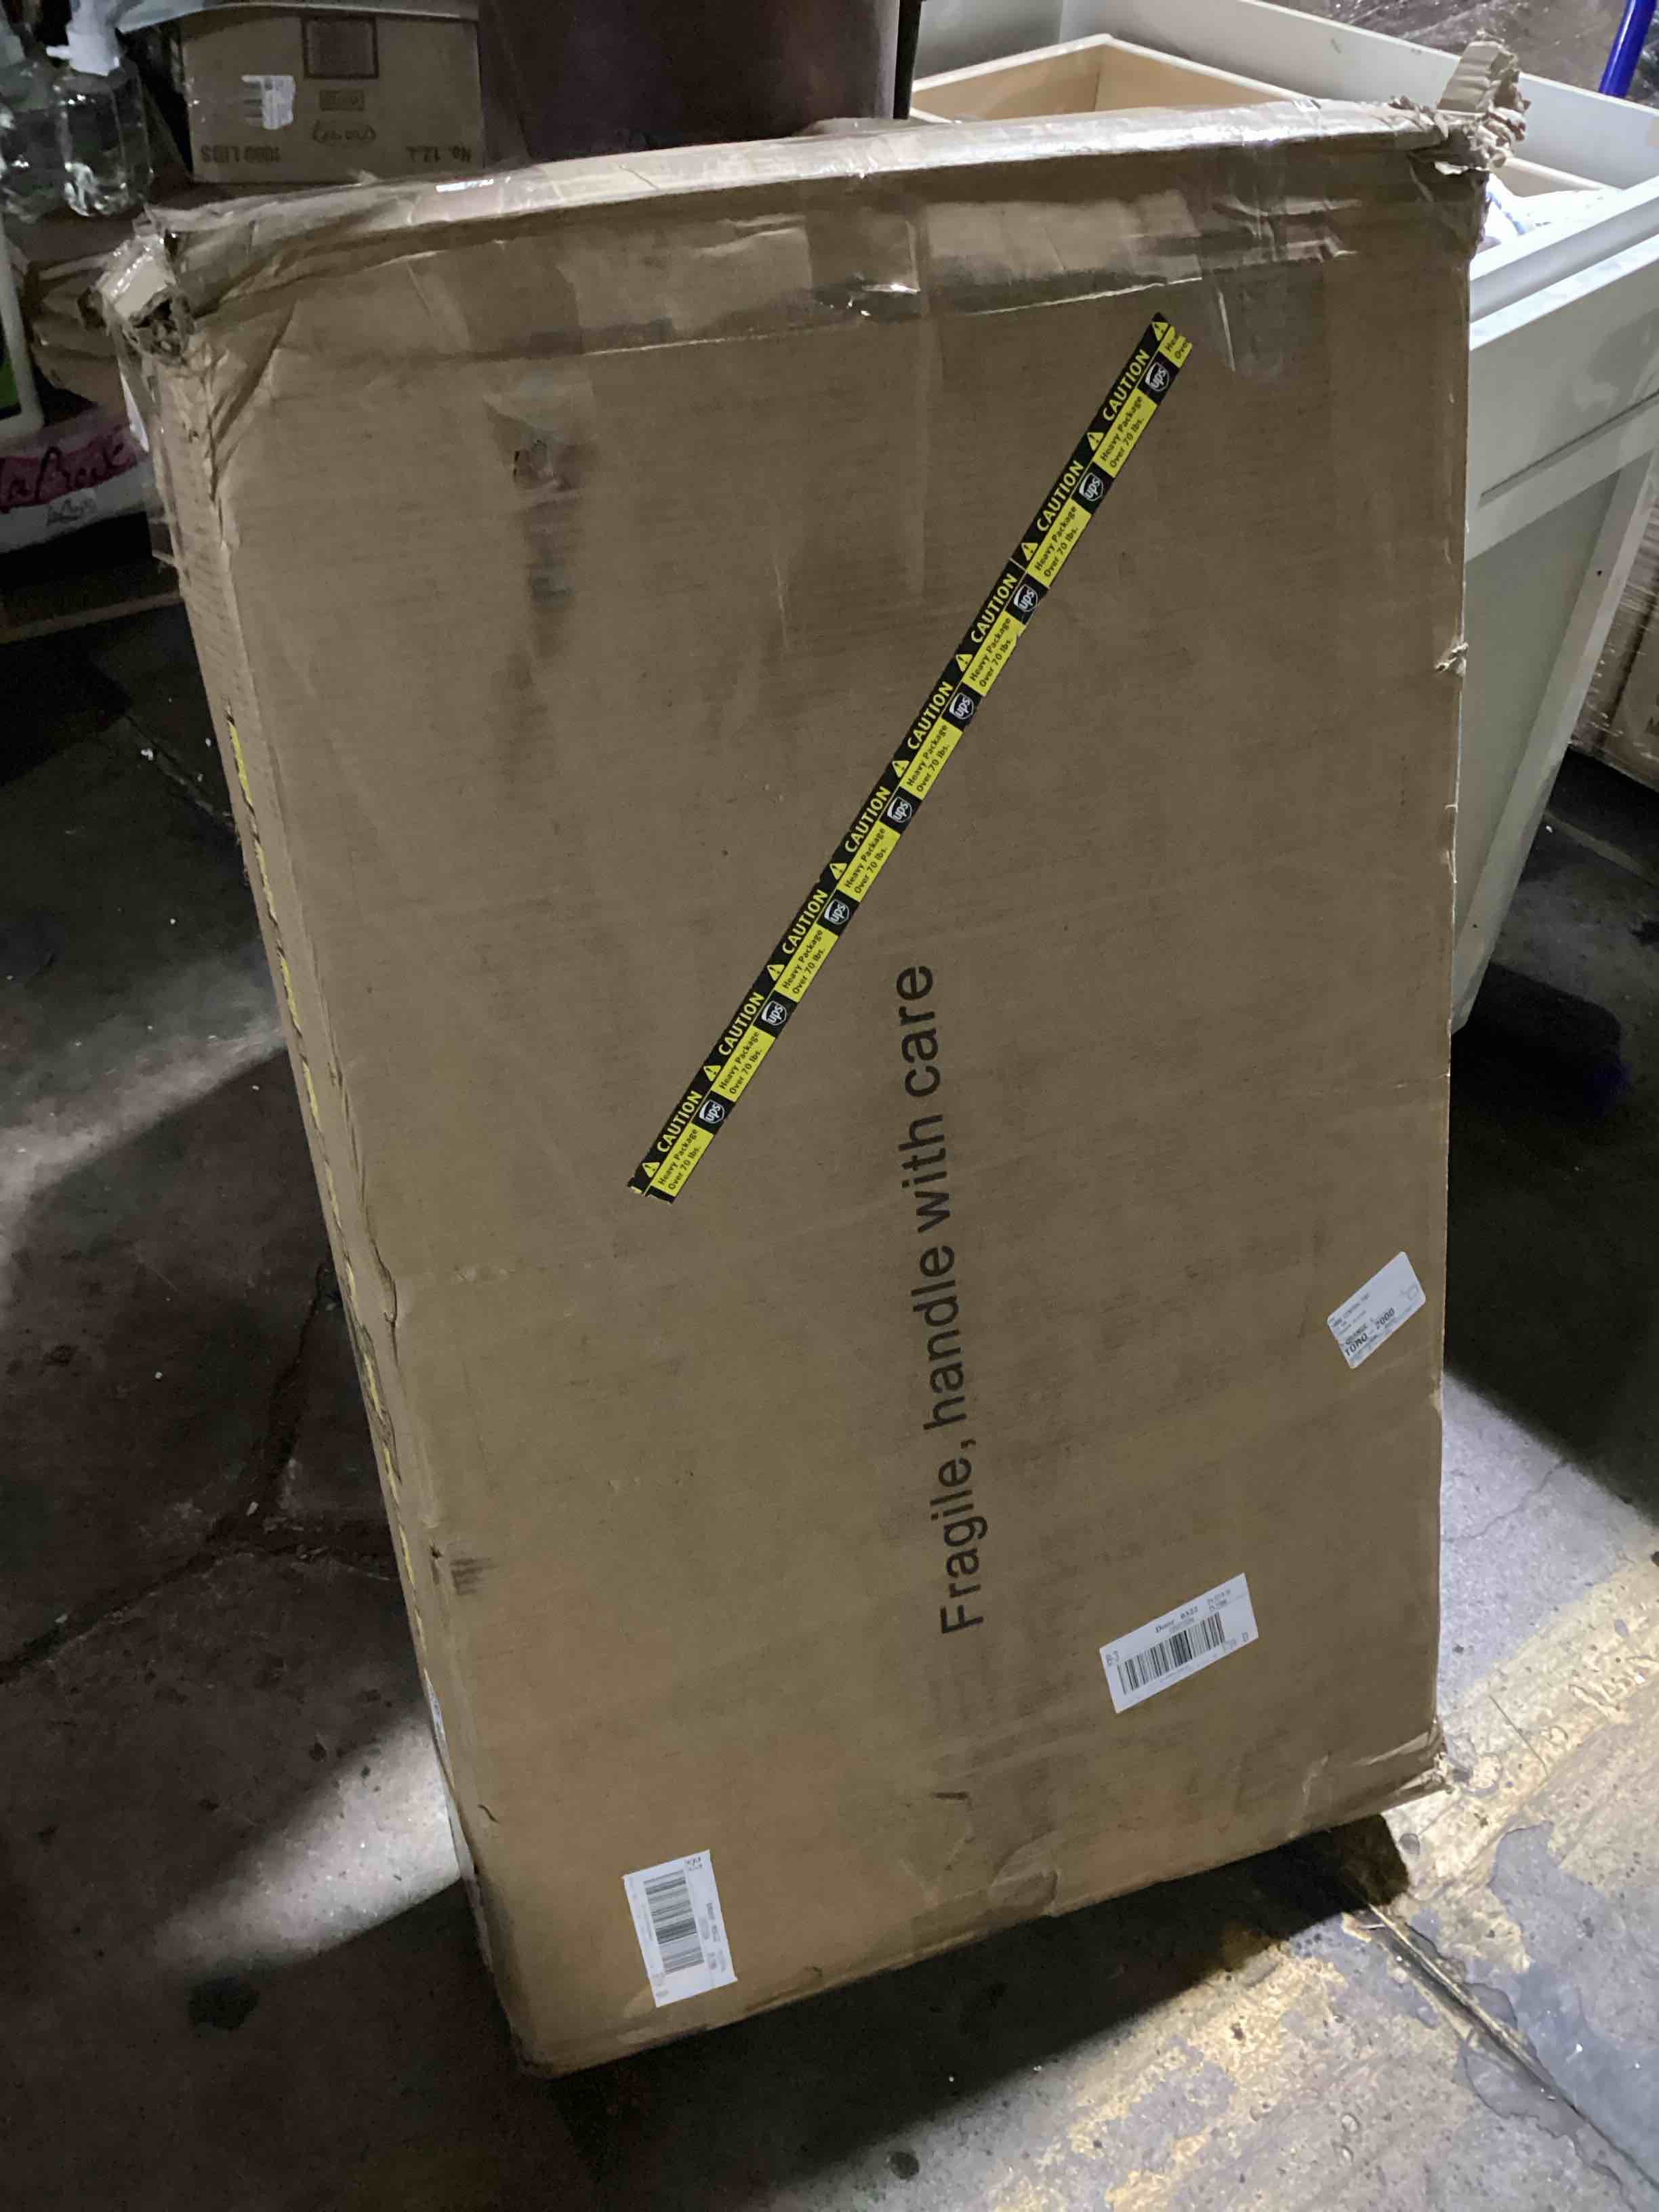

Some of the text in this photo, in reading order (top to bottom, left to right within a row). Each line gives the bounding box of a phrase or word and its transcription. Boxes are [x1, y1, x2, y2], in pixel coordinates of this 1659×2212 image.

[1102, 350, 1149, 421] CAUTION
[1101, 396, 1144, 461] Heavy Package
[1109, 448, 1124, 468] Over
[1123, 432, 1134, 445] 70
[1036, 461, 1083, 531] CAUTION
[1036, 506, 1078, 571] Heavy Package
[1044, 558, 1059, 577] Over
[1058, 542, 1067, 554] 70
[970, 574, 1017, 643] CAUTION
[970, 617, 1012, 681] Heavy Package
[979, 667, 994, 687] Over
[991, 653, 1002, 664] 70
[907, 681, 953, 750] CAUTION
[907, 724, 948, 786] Heavy Package
[916, 773, 930, 792] Over
[928, 759, 939, 770] 70
[844, 785, 889, 853] CAUTION
[844, 827, 886, 888] Heavy Package
[854, 874, 869, 893] Over
[867, 861, 877, 872] 70
[781, 888, 827, 955] CAUTION
[783, 929, 823, 989] Heavy Package
[792, 975, 806, 994] Over
[805, 962, 815, 972] 70
[718, 990, 763, 1057] CAUTION
[720, 1031, 761, 1090] Heavy Package
[730, 1076, 743, 1094] Over
[742, 1063, 752, 1073] 70
[657, 1089, 701, 1153] CAUTION
[658, 1127, 698, 1185] Heavy Package
[668, 1172, 682, 1190] Over
[680, 1160, 690, 1170] 70
[896, 965, 989, 1634] Fragile, handle with care
